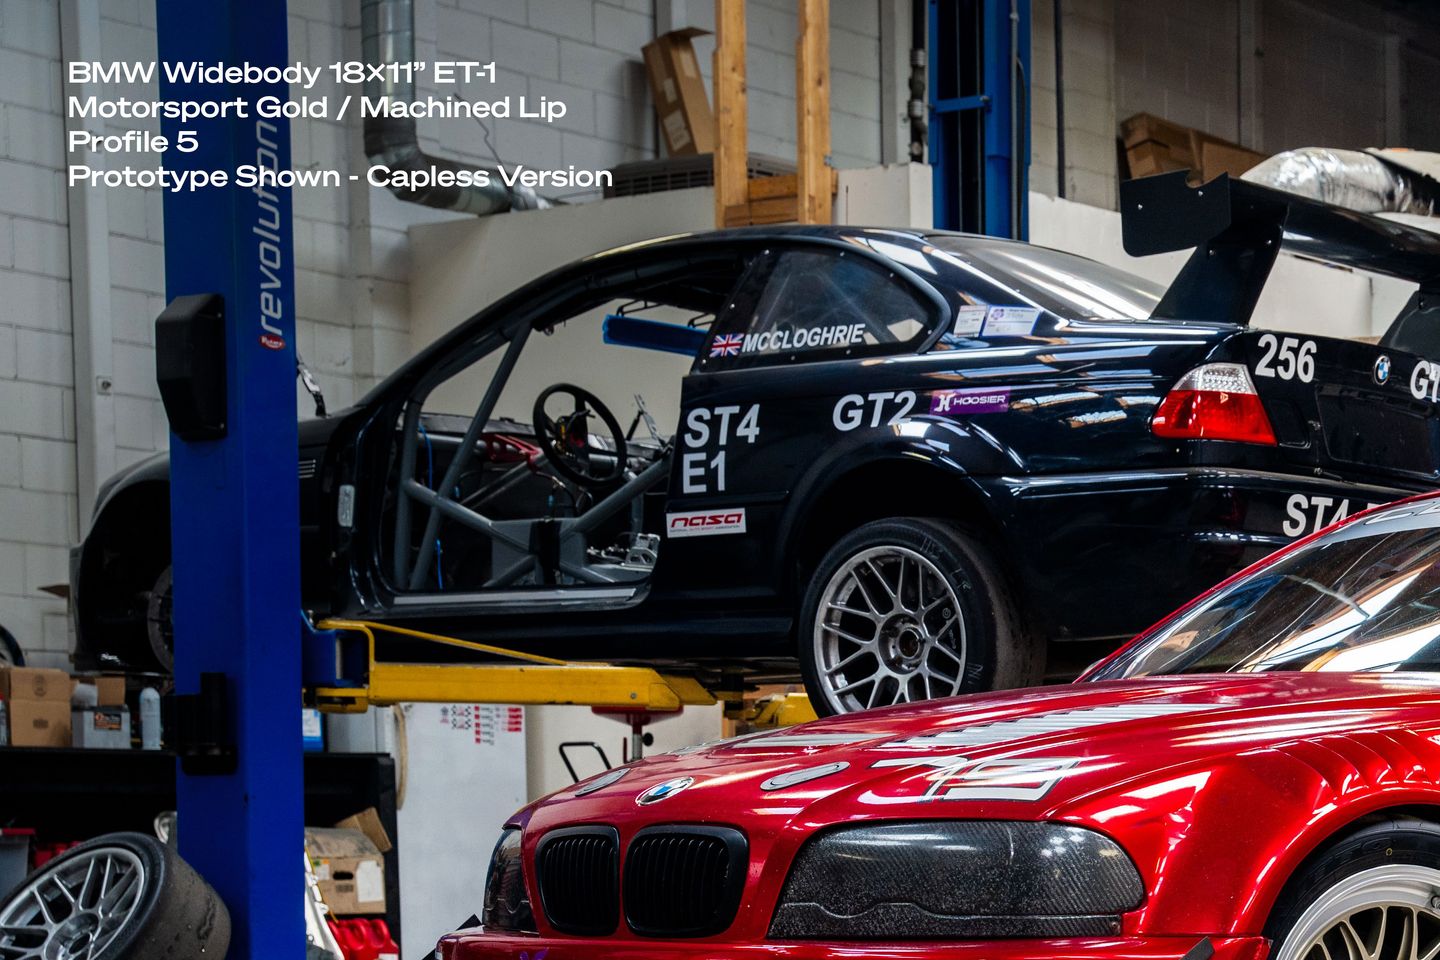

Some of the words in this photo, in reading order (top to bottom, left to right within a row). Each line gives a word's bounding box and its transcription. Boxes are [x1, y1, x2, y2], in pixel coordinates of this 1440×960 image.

[741, 323, 867, 353] MCCLOGHRIE
[1255, 333, 1318, 383] 256
[832, 390, 917, 432] GT2
[953, 395, 1006, 406] HOOSIER
[685, 403, 760, 449] ST4
[682, 450, 728, 494] E1
[671, 513, 743, 528] nasa
